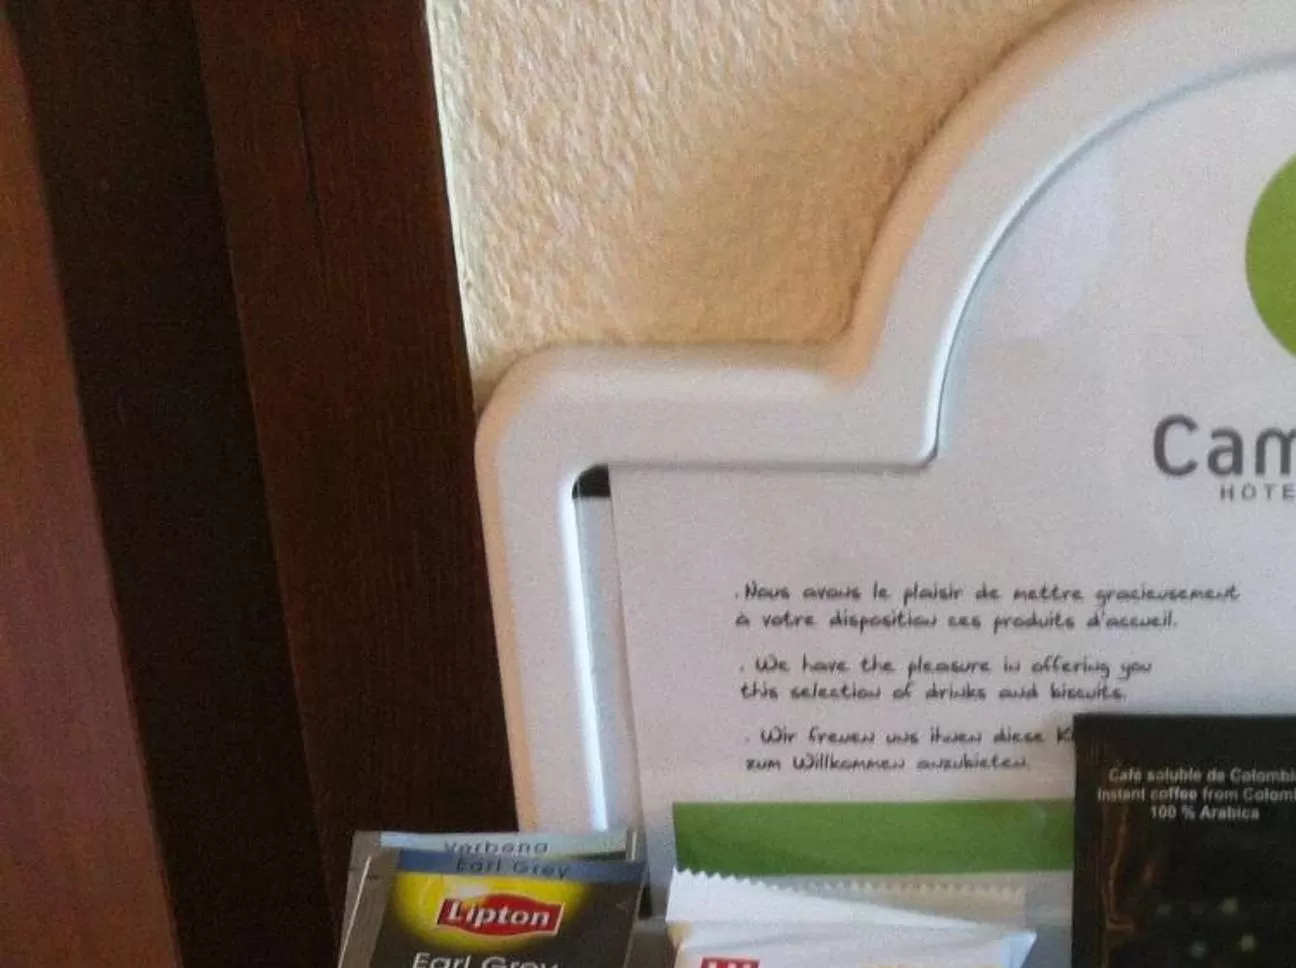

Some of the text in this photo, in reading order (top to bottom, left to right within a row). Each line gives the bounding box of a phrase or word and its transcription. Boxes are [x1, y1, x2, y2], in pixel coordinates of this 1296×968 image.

[744, 580, 1241, 604] Nous avons le plaisir de mettre gracieusement
[763, 613, 815, 628] votre
[829, 609, 938, 634] disposition
[948, 615, 981, 627] ces
[993, 609, 1075, 635] produits
[755, 654, 1153, 680] We have the pleasure in offering you
[740, 683, 778, 700] this
[790, 683, 881, 699] selection
[892, 680, 914, 700] of
[925, 682, 987, 700] drinks
[998, 683, 1039, 699] and
[760, 725, 797, 743] Wir
[808, 726, 876, 744] freuen
[886, 733, 920, 745] uns
[993, 725, 1045, 743] diese
[745, 758, 782, 771] zum
[792, 751, 906, 770] Willkommen
[1147, 768, 1200, 782] soluble
[1207, 768, 1226, 782] de
[1150, 786, 1198, 800] coffee
[1203, 786, 1239, 800] from
[1150, 805, 1260, 820] 100 % Arabica
[456, 858, 569, 880] Earl Grey
[447, 902, 551, 928] Lipton
